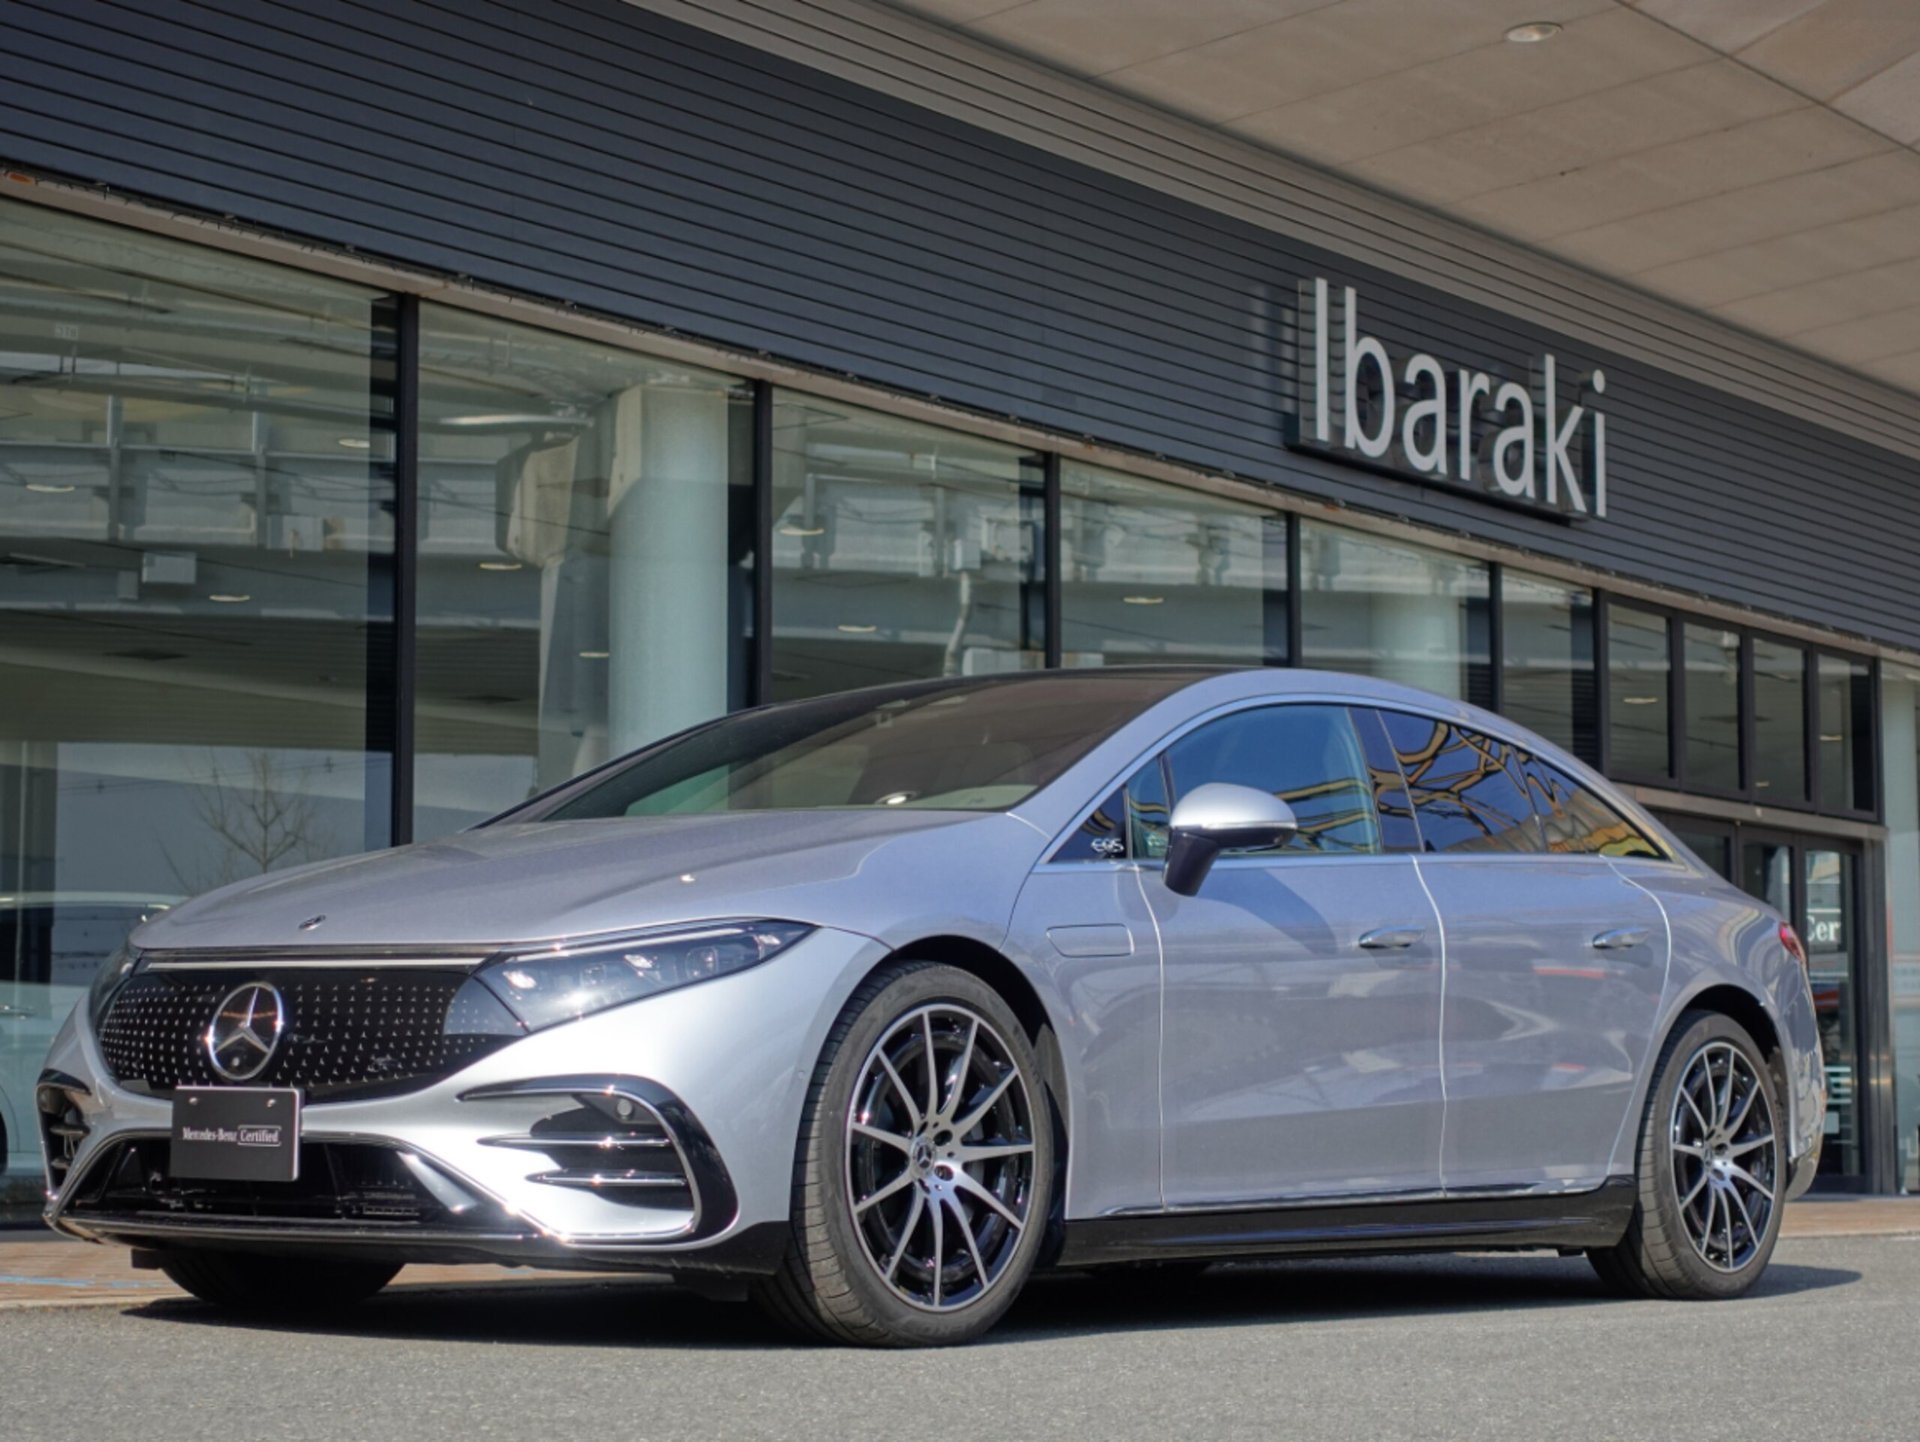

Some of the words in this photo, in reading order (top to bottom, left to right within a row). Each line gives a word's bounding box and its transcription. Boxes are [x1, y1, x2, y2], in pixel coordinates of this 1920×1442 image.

[1315, 277, 1606, 517] Ibaraki
[182, 1126, 238, 1142] Mercedes-Benz
[240, 1129, 279, 1143] Certified
